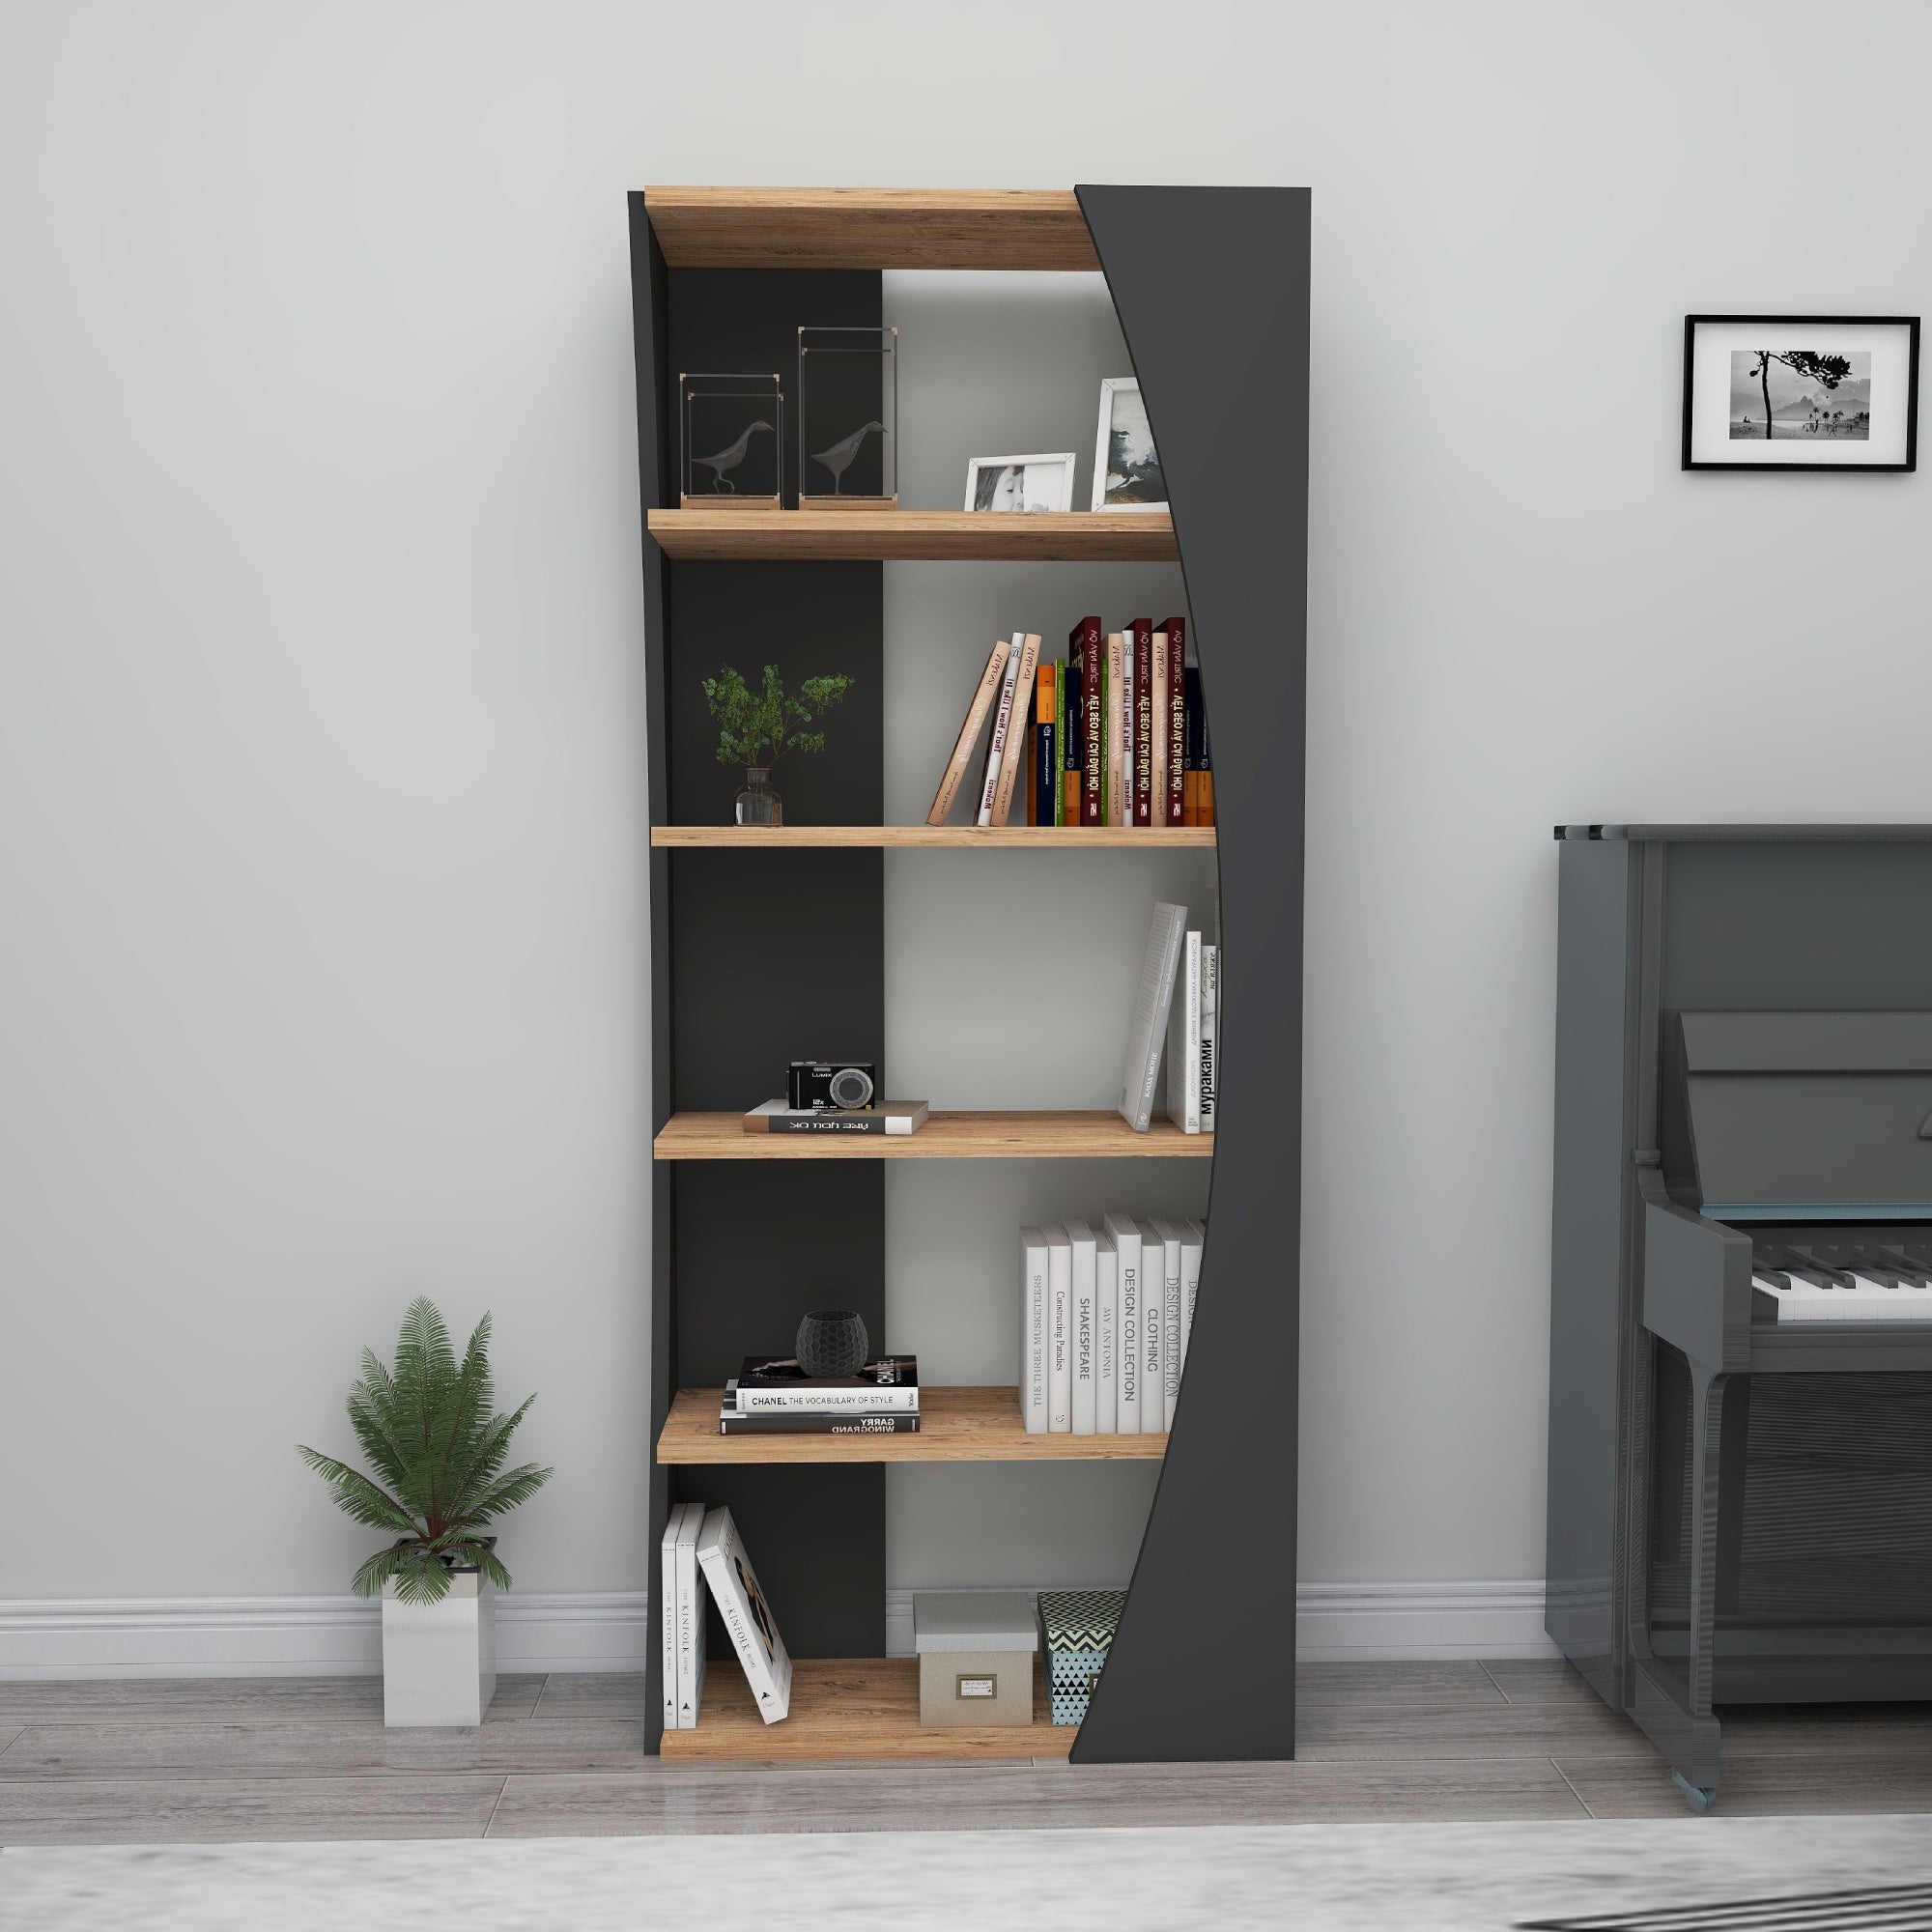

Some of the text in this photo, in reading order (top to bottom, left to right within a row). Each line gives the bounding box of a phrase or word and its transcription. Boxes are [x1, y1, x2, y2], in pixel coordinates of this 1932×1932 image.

[1201, 1039, 1214, 1115] мураками
[1054, 1291, 1065, 1339] Constructing
[1079, 1298, 1090, 1379] SHAKESPEARE
[1103, 1307, 1111, 1324] MY
[1124, 1268, 1135, 1401] DESIGN COLLECTION
[1148, 1308, 1158, 1372] CLOTHING
[1165, 1277, 1179, 1397] DESIGN COLLECTION
[876, 1359, 895, 1384] CHANEL
[752, 1397, 787, 1406] CHANEL
[725, 1608, 752, 1652] KINFOLK
